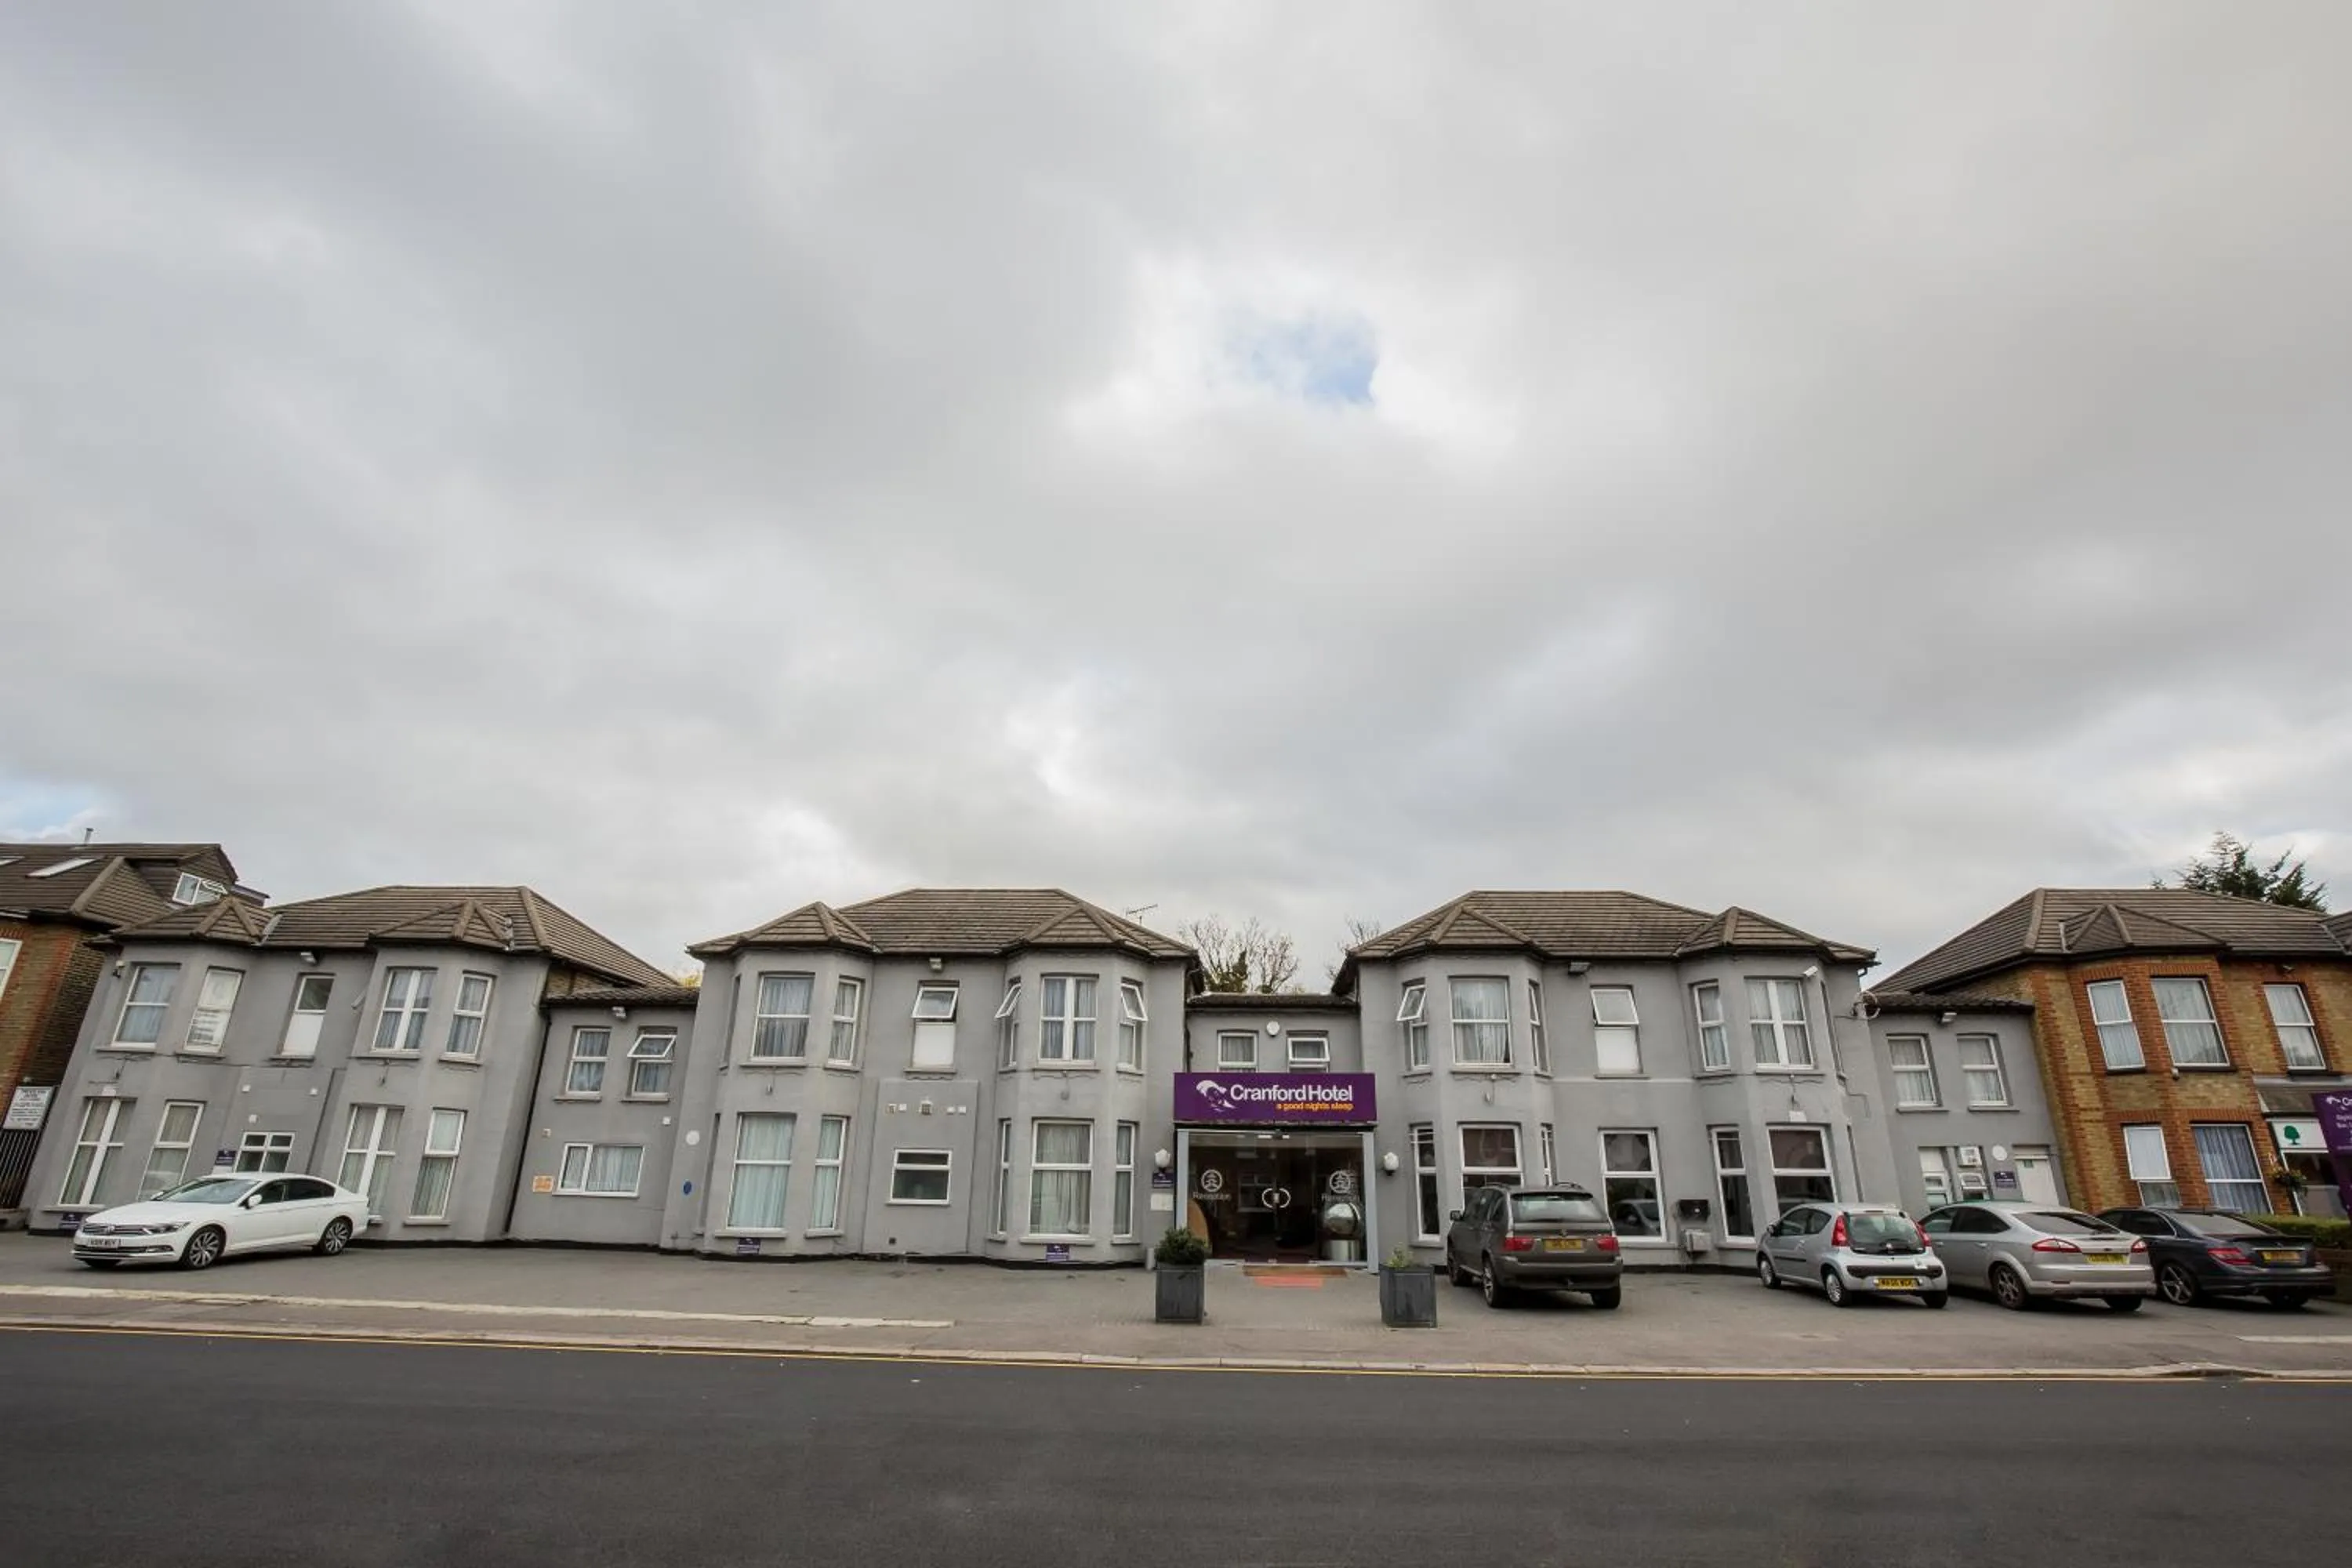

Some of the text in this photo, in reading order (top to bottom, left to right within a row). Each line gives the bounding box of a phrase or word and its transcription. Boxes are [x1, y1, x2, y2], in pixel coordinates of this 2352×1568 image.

[1230, 1084, 1352, 1102] Cranford Hotel
[1283, 1102, 1303, 1112] good
[1331, 1102, 1354, 1111] sleep
